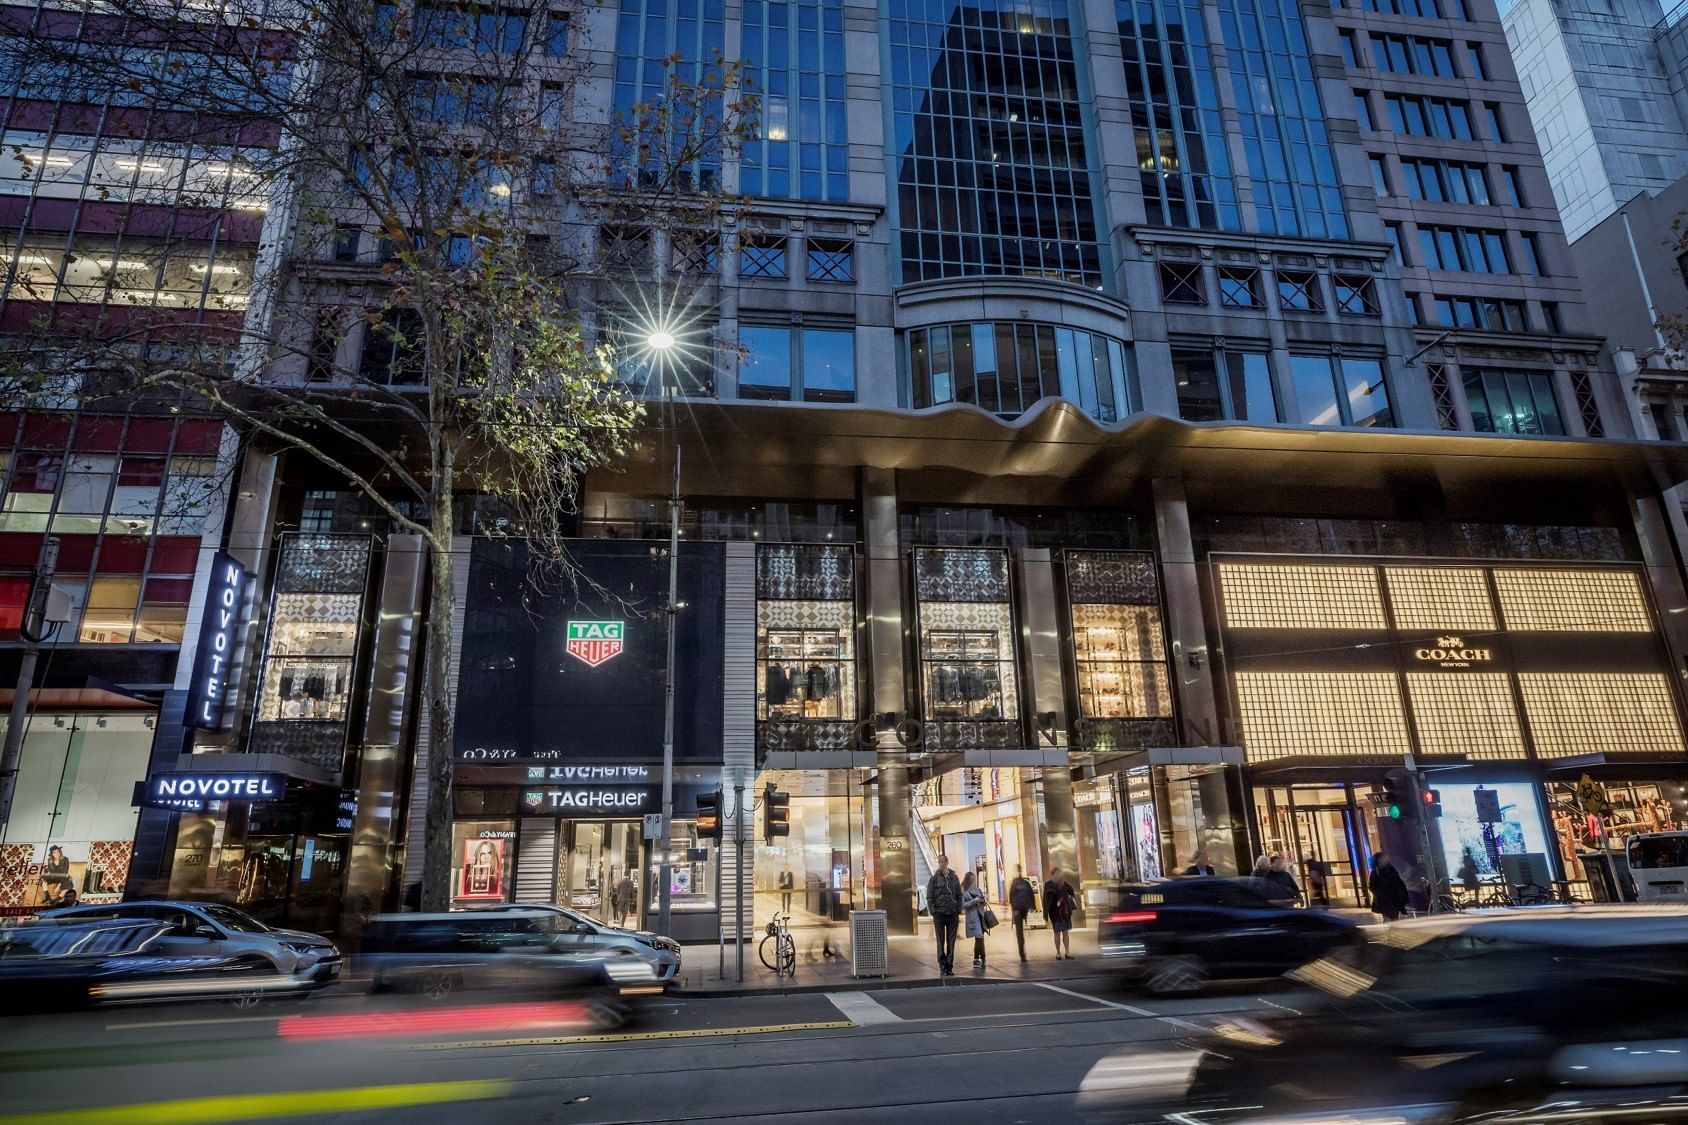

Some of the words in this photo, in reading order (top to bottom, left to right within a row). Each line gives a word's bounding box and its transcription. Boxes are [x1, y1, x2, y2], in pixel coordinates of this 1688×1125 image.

[572, 623, 618, 638] TAG
[202, 564, 239, 721] NOVOTEL
[570, 640, 620, 663] HEUER
[1415, 648, 1491, 660] COACH
[158, 779, 273, 795] NOVOTEL
[548, 791, 647, 807] TAGHeuer
[886, 841, 902, 849] 260
[184, 854, 203, 863] 270
